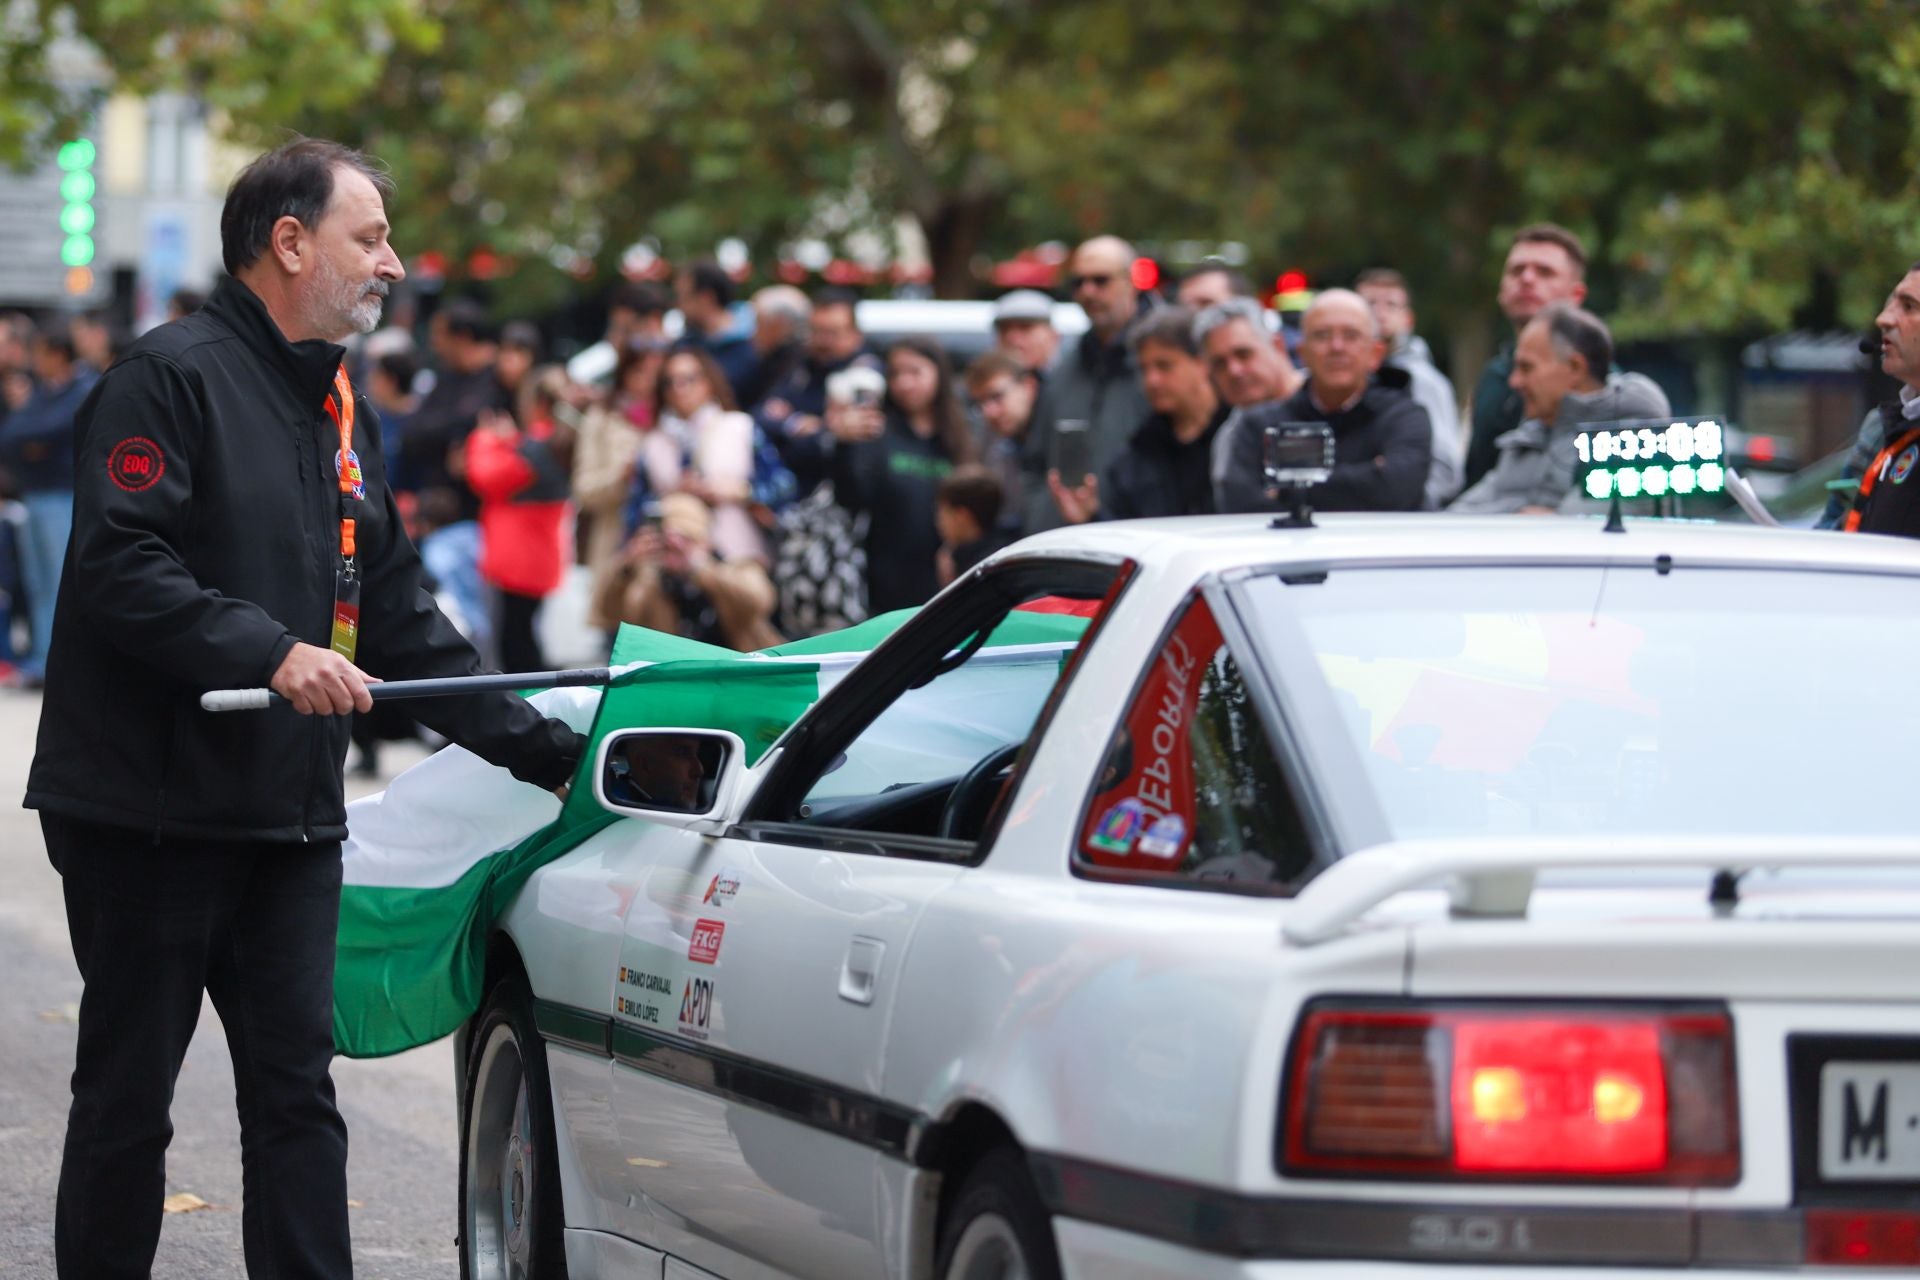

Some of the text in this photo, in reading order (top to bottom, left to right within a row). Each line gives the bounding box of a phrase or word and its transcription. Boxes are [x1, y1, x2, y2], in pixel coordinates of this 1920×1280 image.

[626, 969, 672, 995] FRANCI CARVAJAL
[624, 999, 660, 1023] EMILIO LÓPEZ
